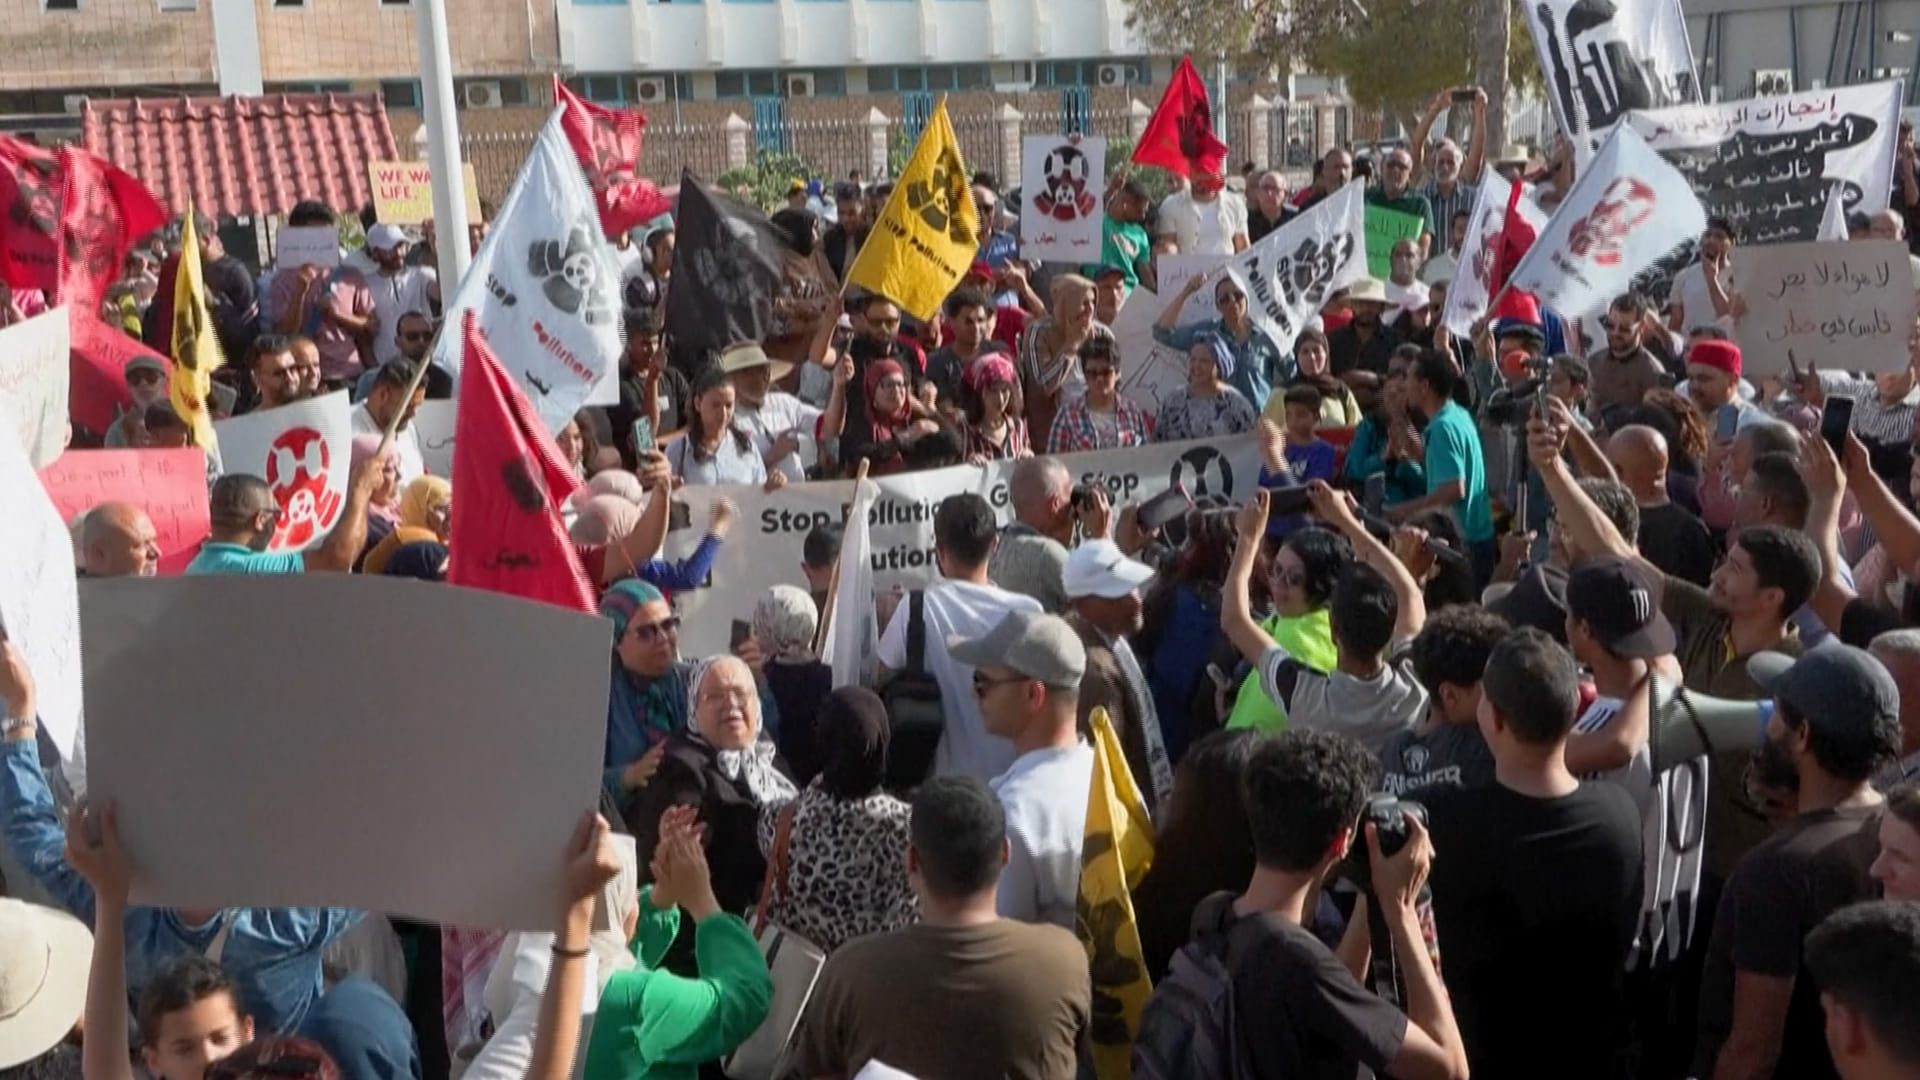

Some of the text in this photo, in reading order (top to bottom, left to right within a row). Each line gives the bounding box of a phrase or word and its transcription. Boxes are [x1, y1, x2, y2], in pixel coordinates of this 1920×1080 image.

[378, 169, 402, 182] WE
[1814, 259, 1830, 287] لا
[1874, 259, 1891, 289] لا
[761, 508, 831, 534] Stop
[871, 544, 938, 571] ution
